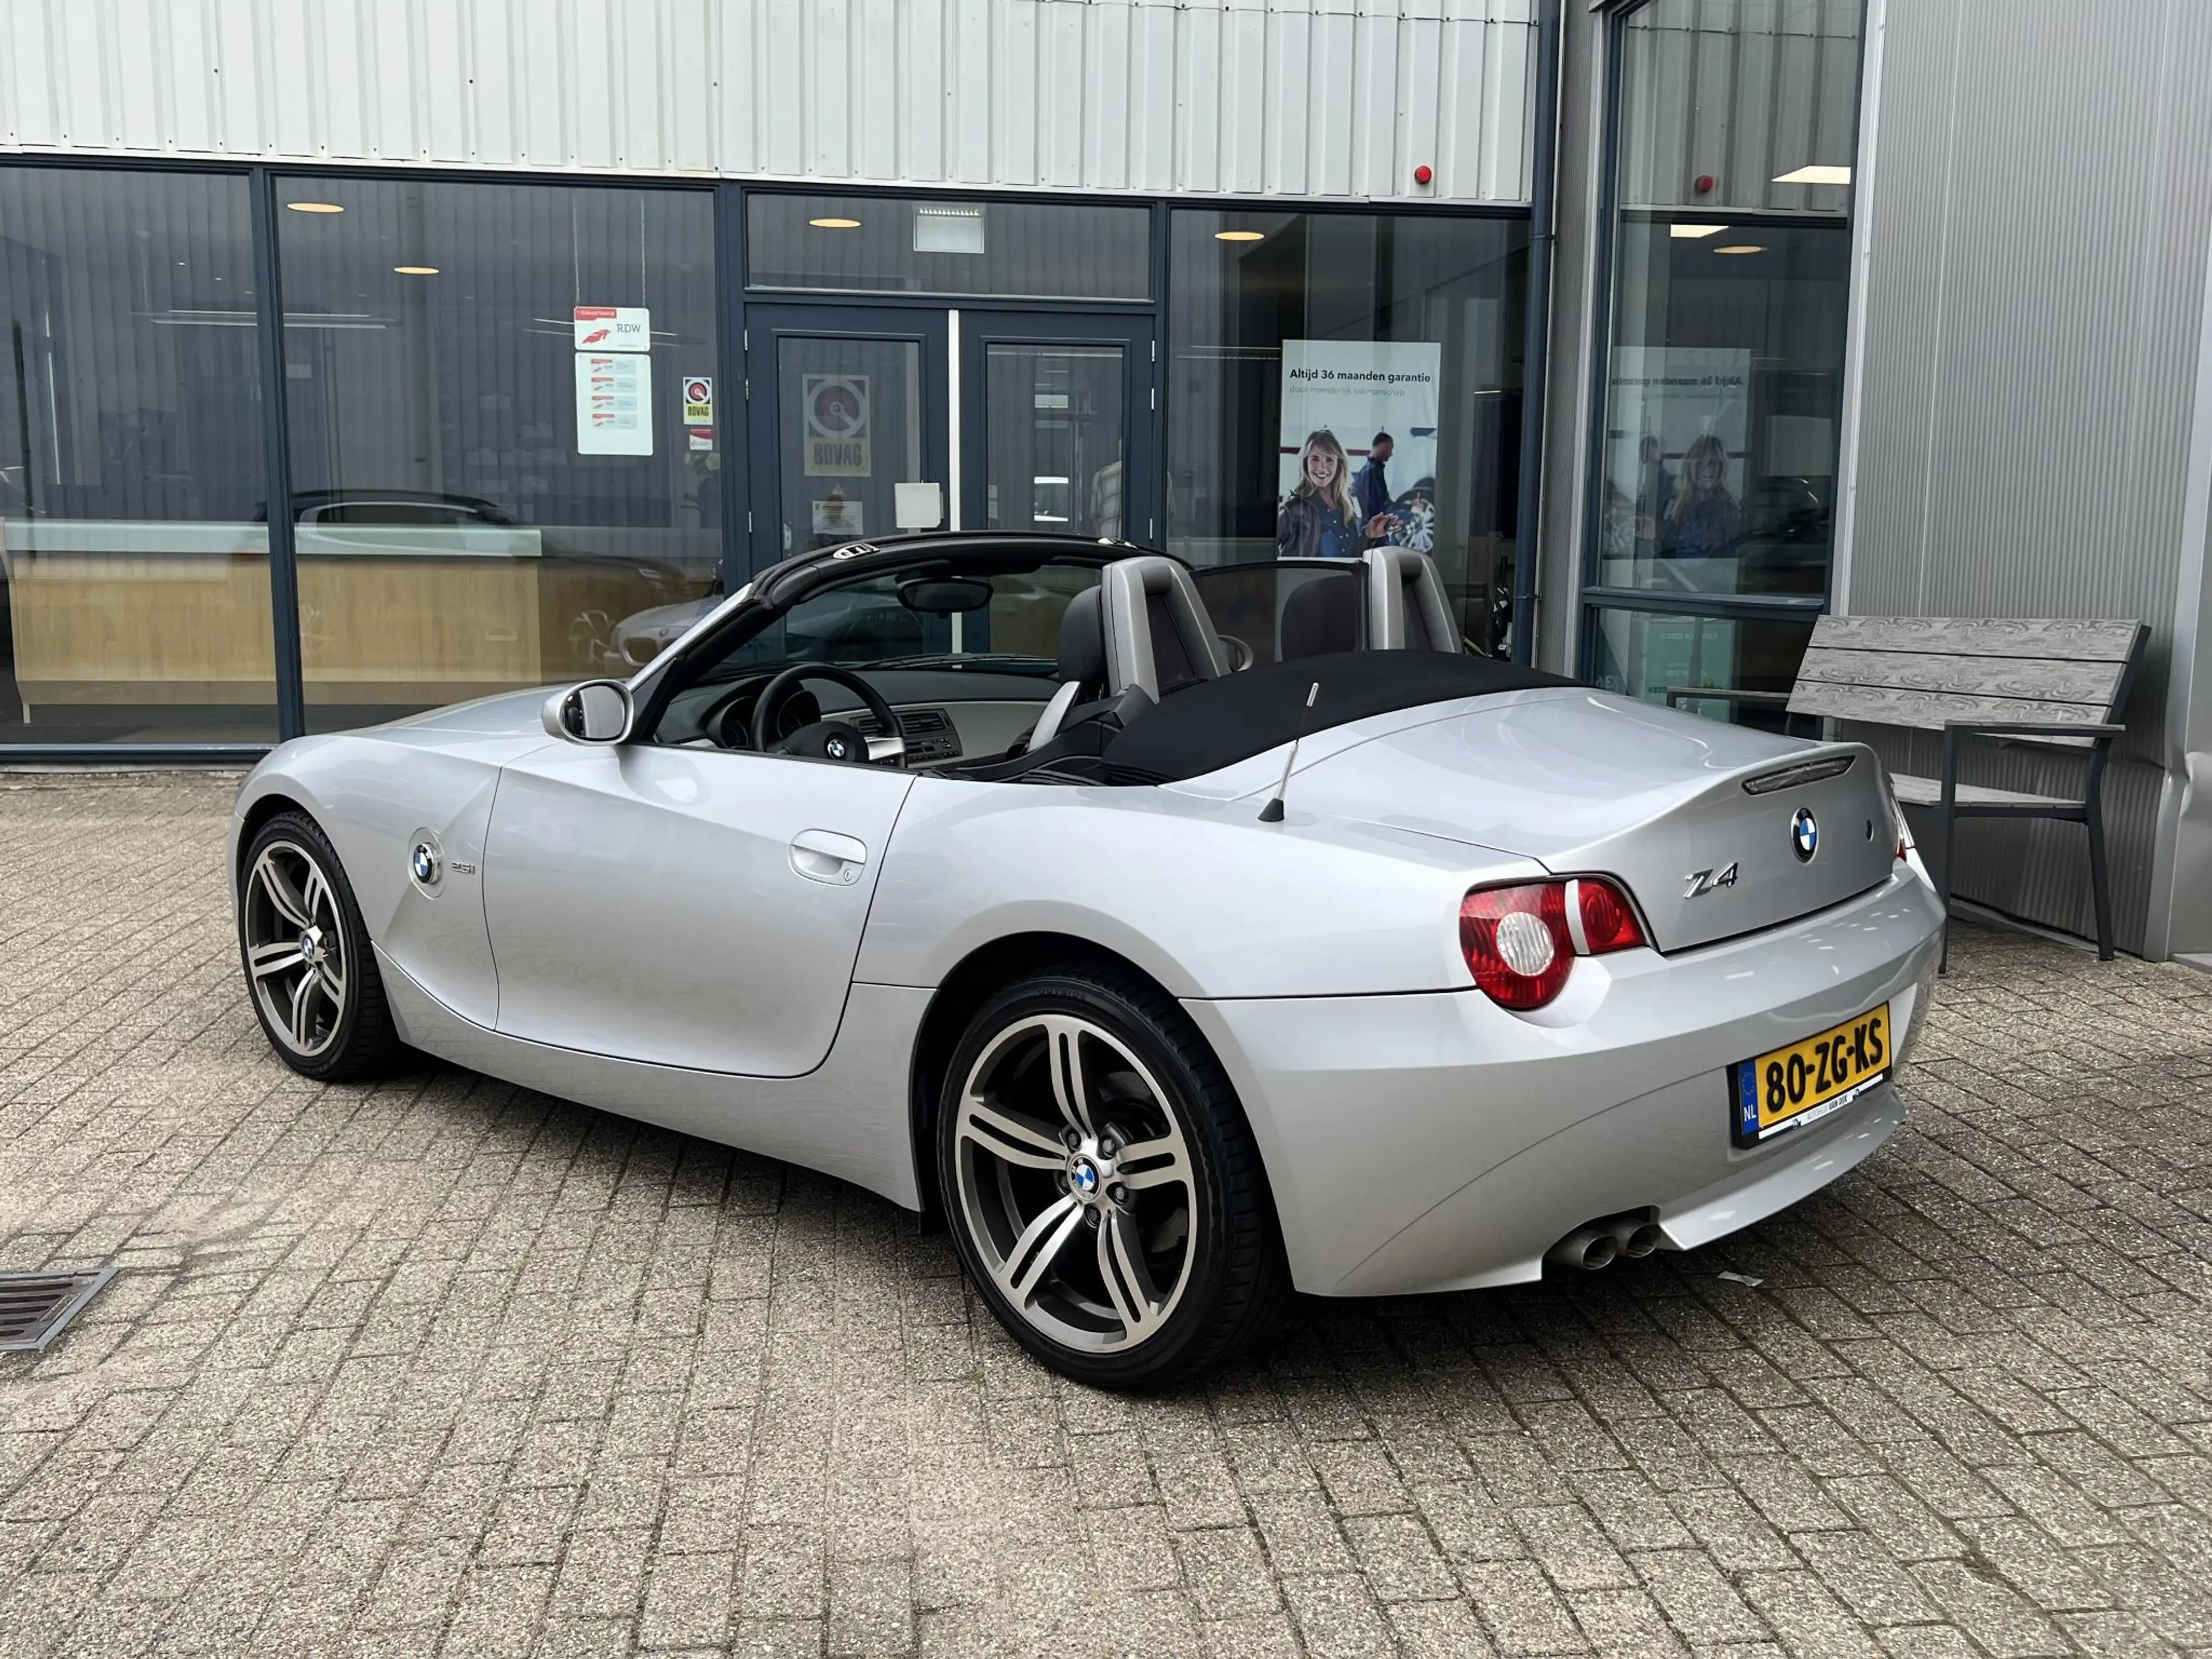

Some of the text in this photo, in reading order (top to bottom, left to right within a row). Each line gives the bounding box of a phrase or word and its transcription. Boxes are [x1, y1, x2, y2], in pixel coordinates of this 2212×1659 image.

[616, 324, 641, 332] RDW
[1290, 369, 1431, 383] Altijd 36 maanden garantie
[688, 406, 710, 416] BOVAG
[814, 442, 862, 467] BOVAG
[1683, 862, 1739, 899] Z4
[1766, 1018, 1883, 1113] 80-ZG-KS
[1743, 1104, 1756, 1122] NL
